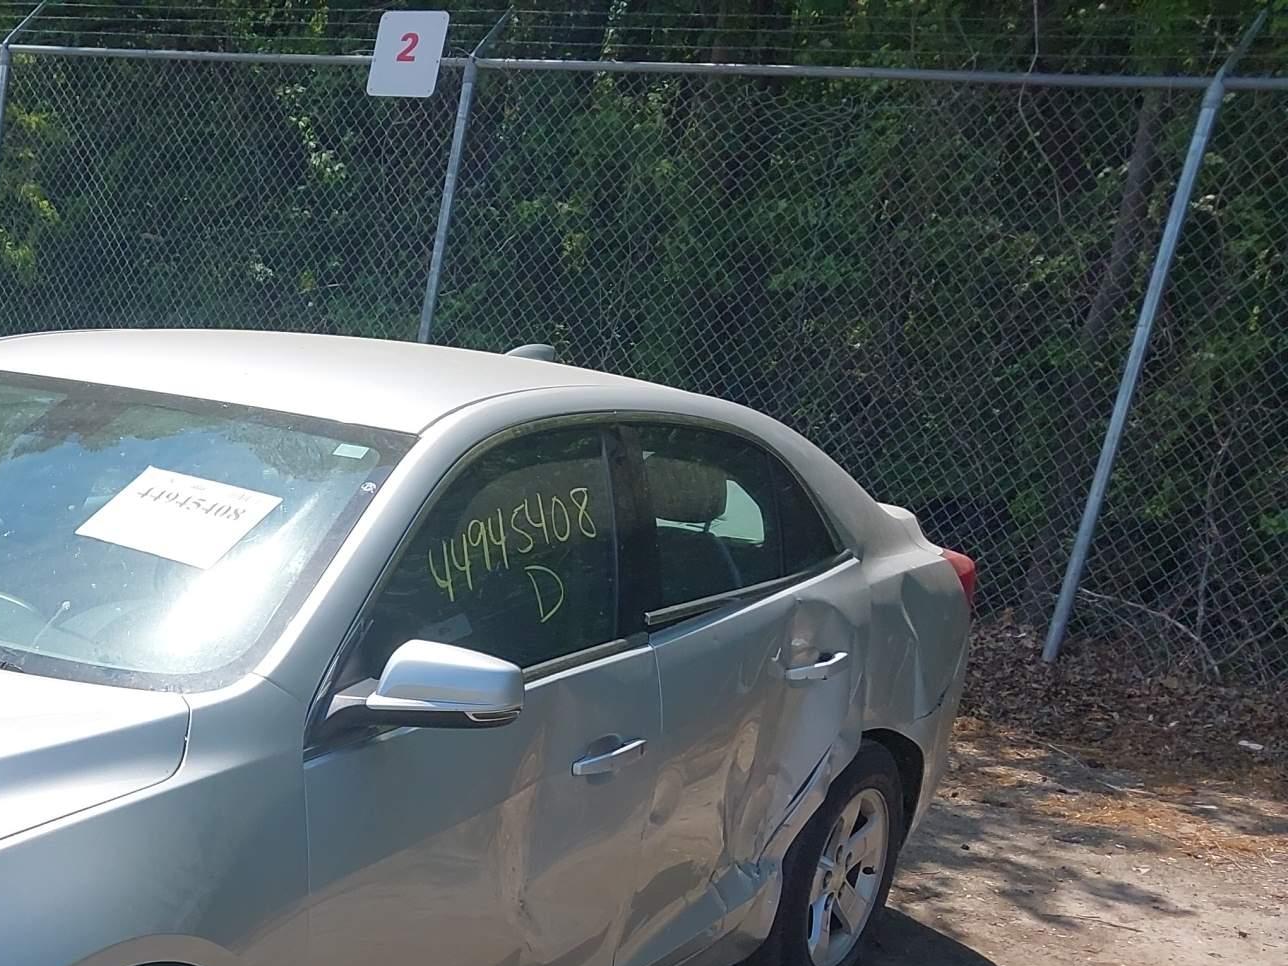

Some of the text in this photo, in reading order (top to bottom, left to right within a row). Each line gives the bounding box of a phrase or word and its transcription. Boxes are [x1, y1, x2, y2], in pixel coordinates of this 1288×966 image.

[396, 32, 420, 62] 2
[137, 487, 246, 521] 44945408
[428, 487, 597, 602] 44945408
[524, 565, 564, 623] D
